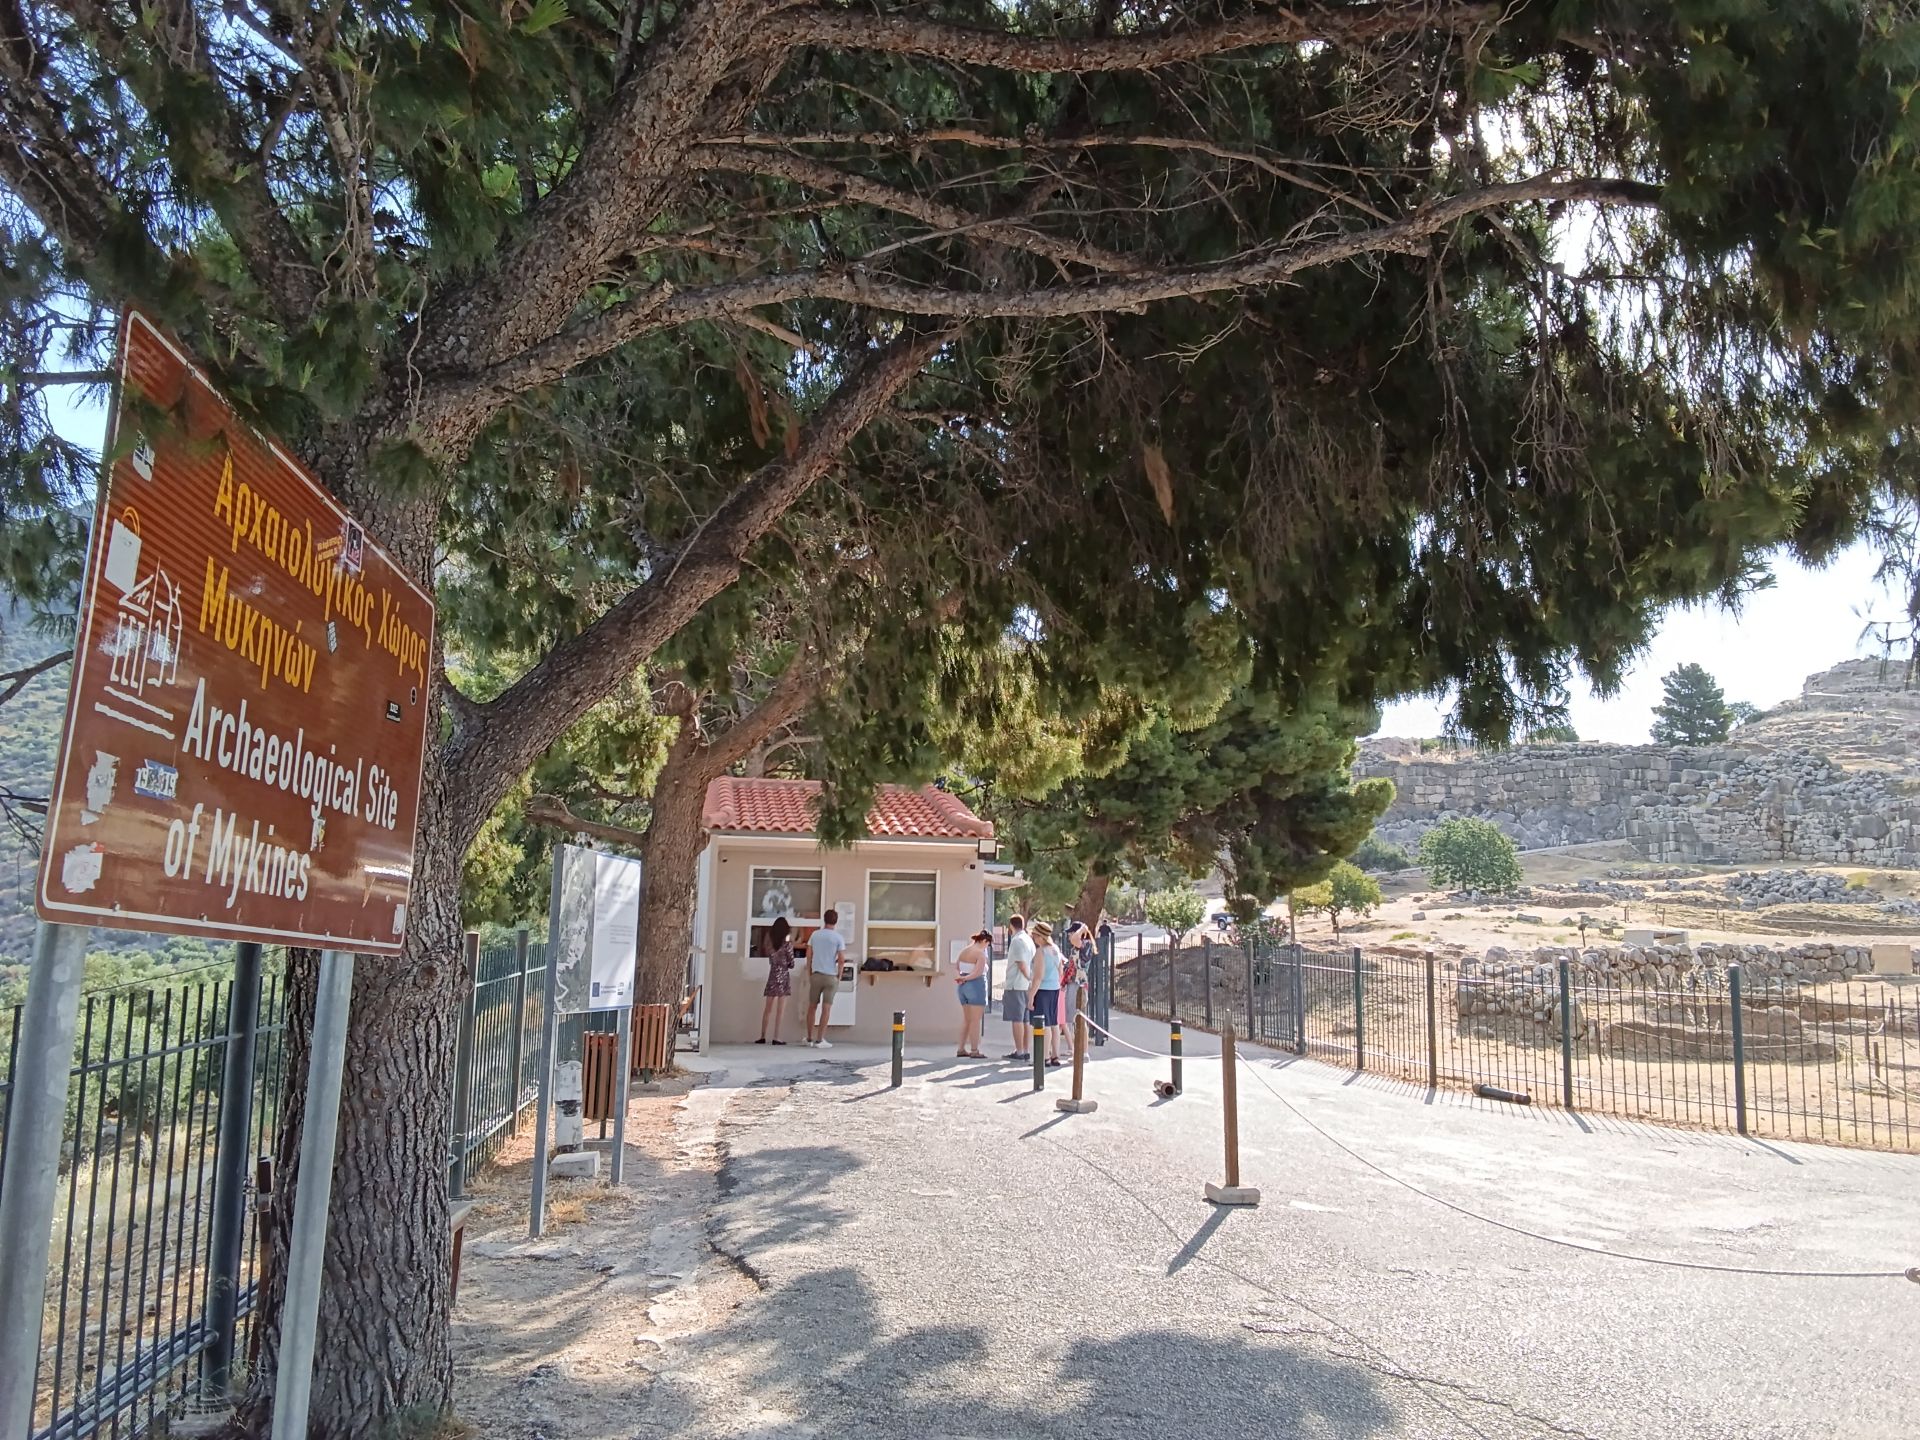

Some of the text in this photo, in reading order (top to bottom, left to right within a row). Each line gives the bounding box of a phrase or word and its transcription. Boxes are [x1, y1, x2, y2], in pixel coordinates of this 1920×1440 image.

[199, 556, 316, 693] Μυκηνών
[214, 449, 426, 689] Αρχαιολογικός Χώρος
[182, 677, 398, 831] Archaeological Site
[164, 803, 311, 909] of Mykines
